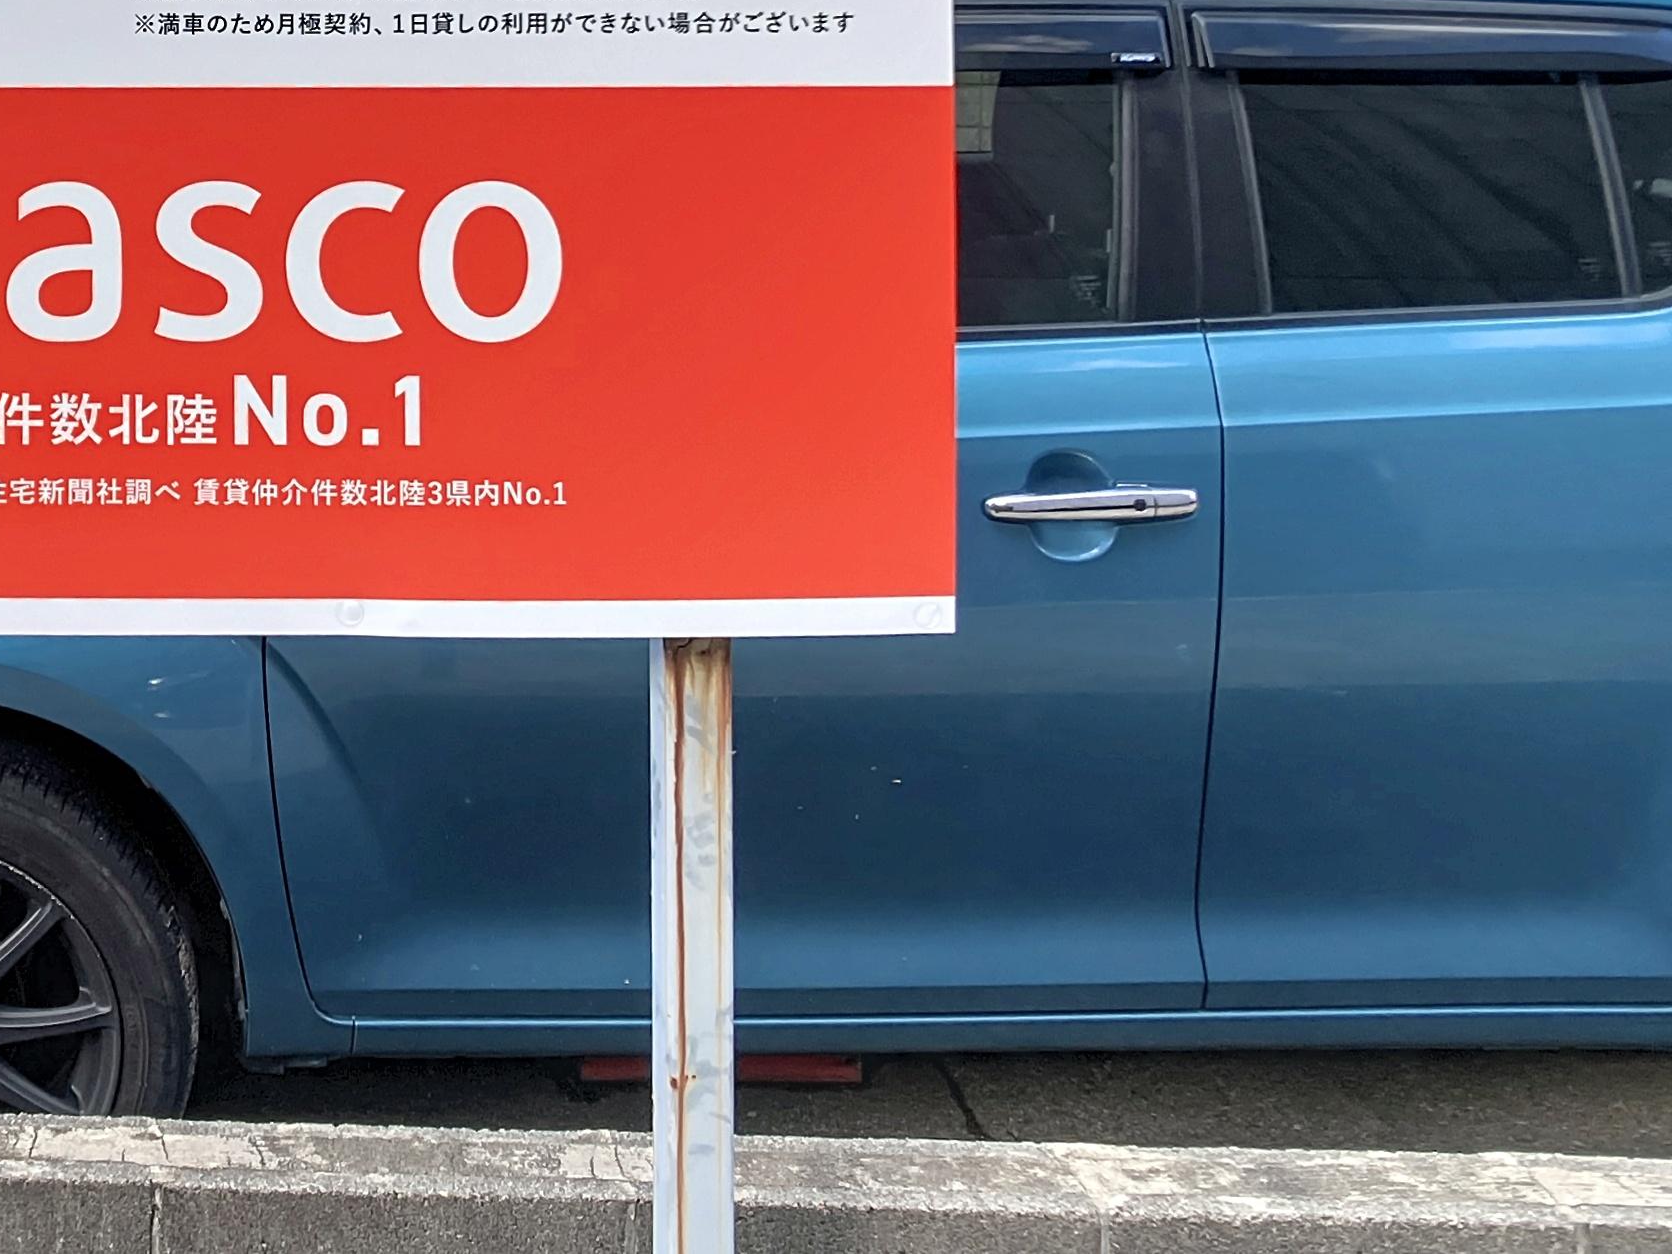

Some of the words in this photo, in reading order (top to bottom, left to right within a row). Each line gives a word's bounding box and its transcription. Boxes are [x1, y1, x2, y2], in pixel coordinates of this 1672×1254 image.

[193, 478, 567, 507] 賃貸仲介件数北陸3県内No.1
